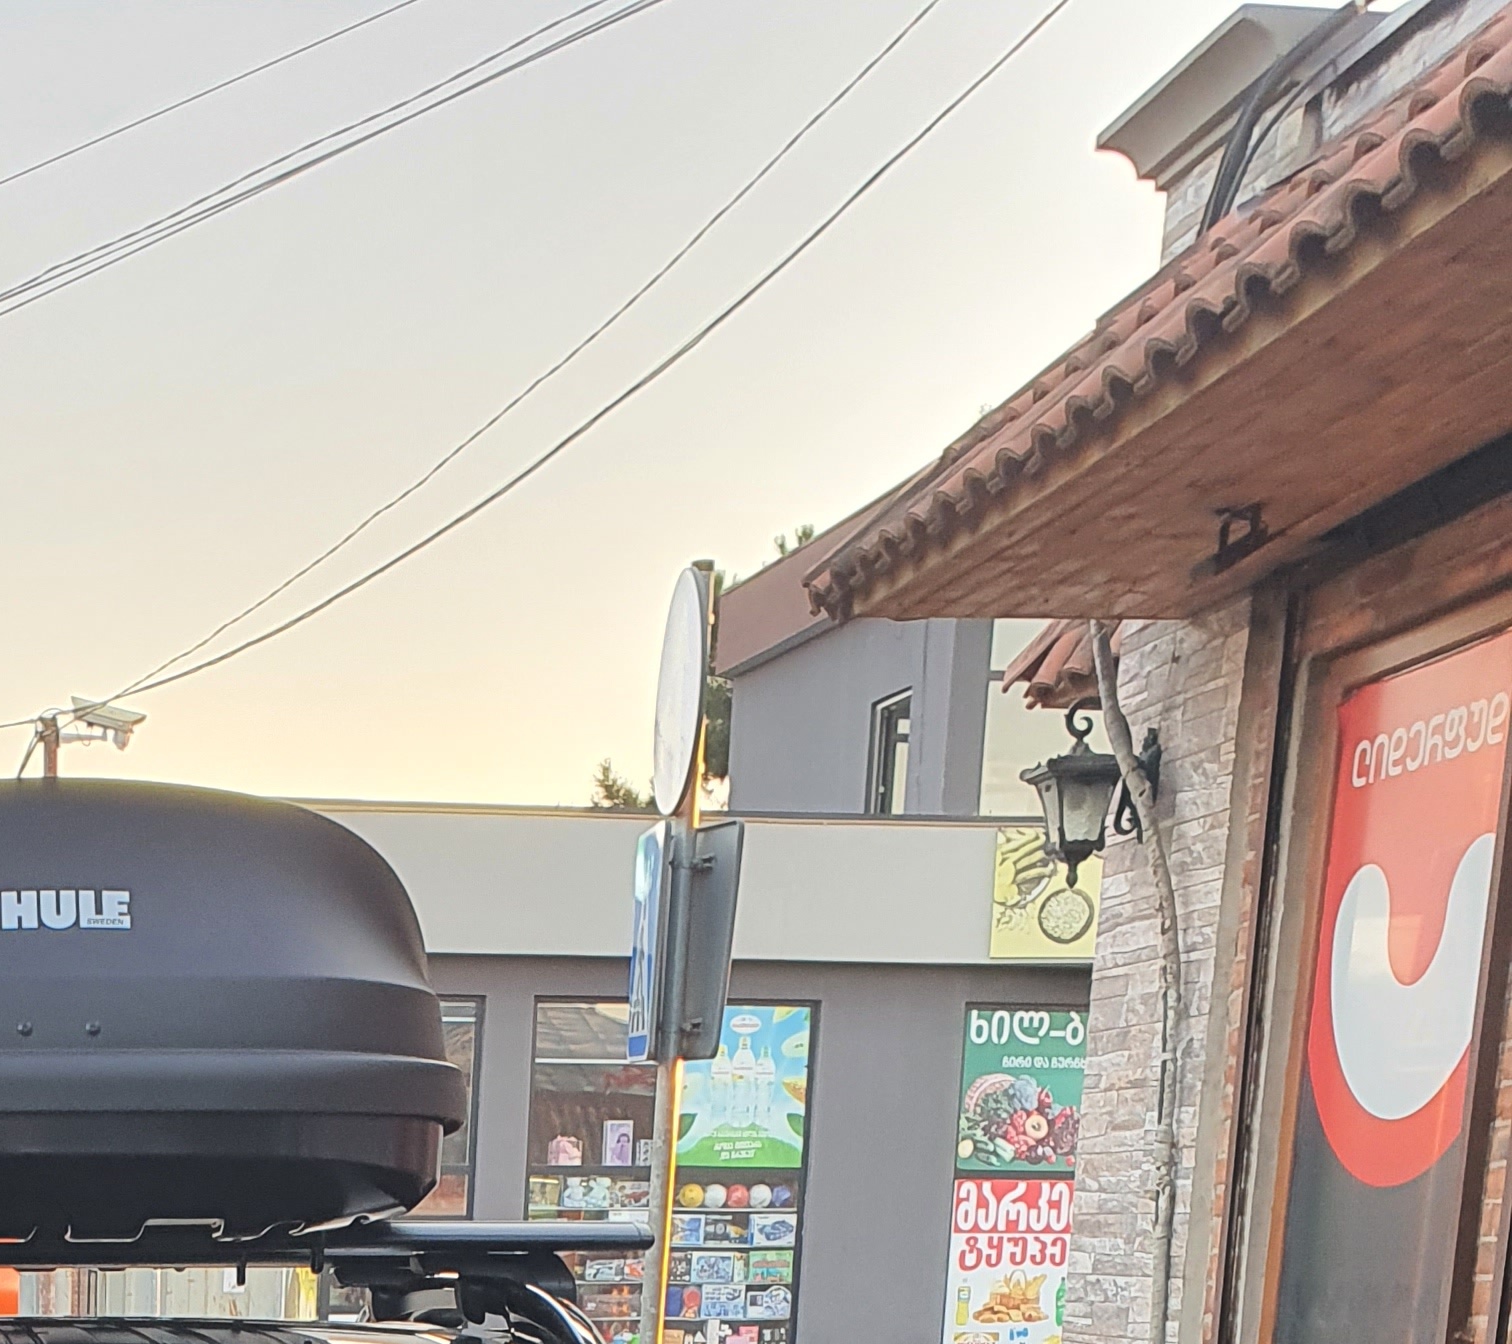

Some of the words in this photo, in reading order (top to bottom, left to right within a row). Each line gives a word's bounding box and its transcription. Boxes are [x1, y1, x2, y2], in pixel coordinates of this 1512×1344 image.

[87, 917, 124, 926] SWEDEN
[1034, 1056, 1049, 1069] და
[956, 1181, 1073, 1232] მარკე
